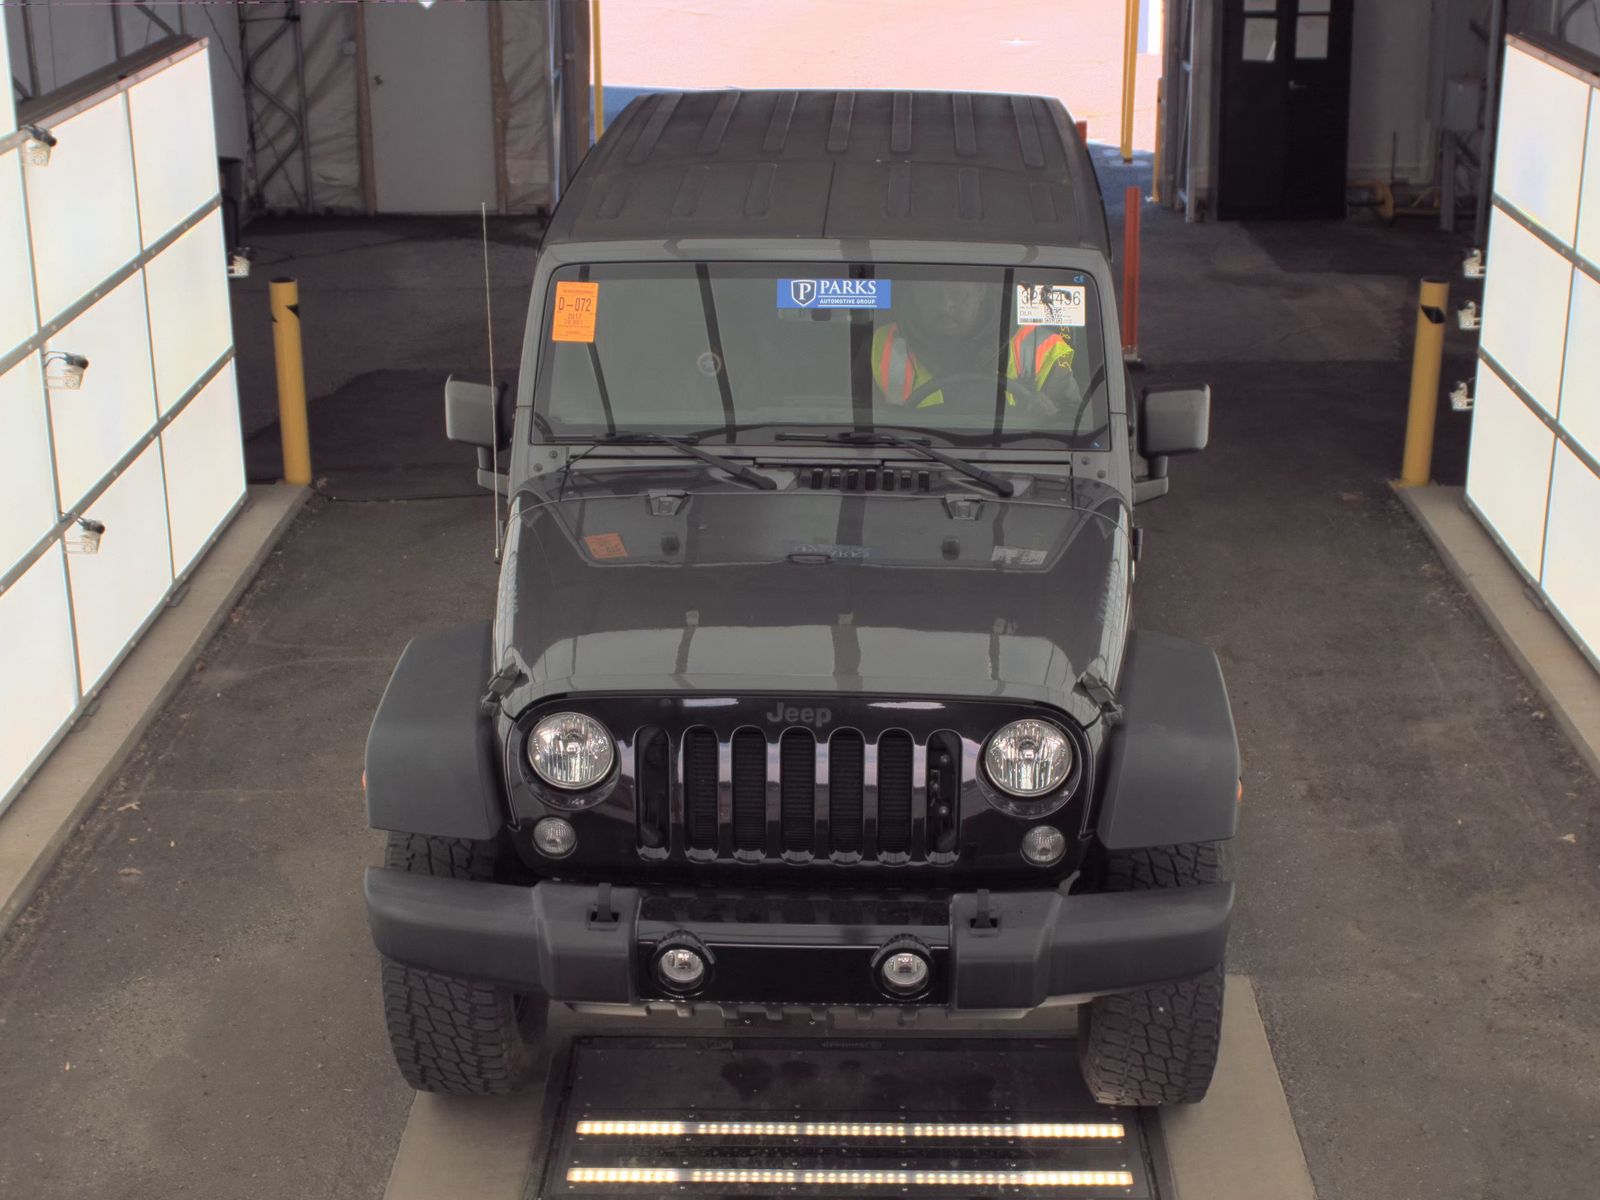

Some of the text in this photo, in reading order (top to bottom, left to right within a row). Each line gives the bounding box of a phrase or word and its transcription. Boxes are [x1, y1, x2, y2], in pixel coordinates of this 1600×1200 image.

[798, 282, 812, 300] P
[820, 280, 877, 295] PARKS
[558, 296, 592, 312] D-072
[766, 702, 832, 728] Jeep
